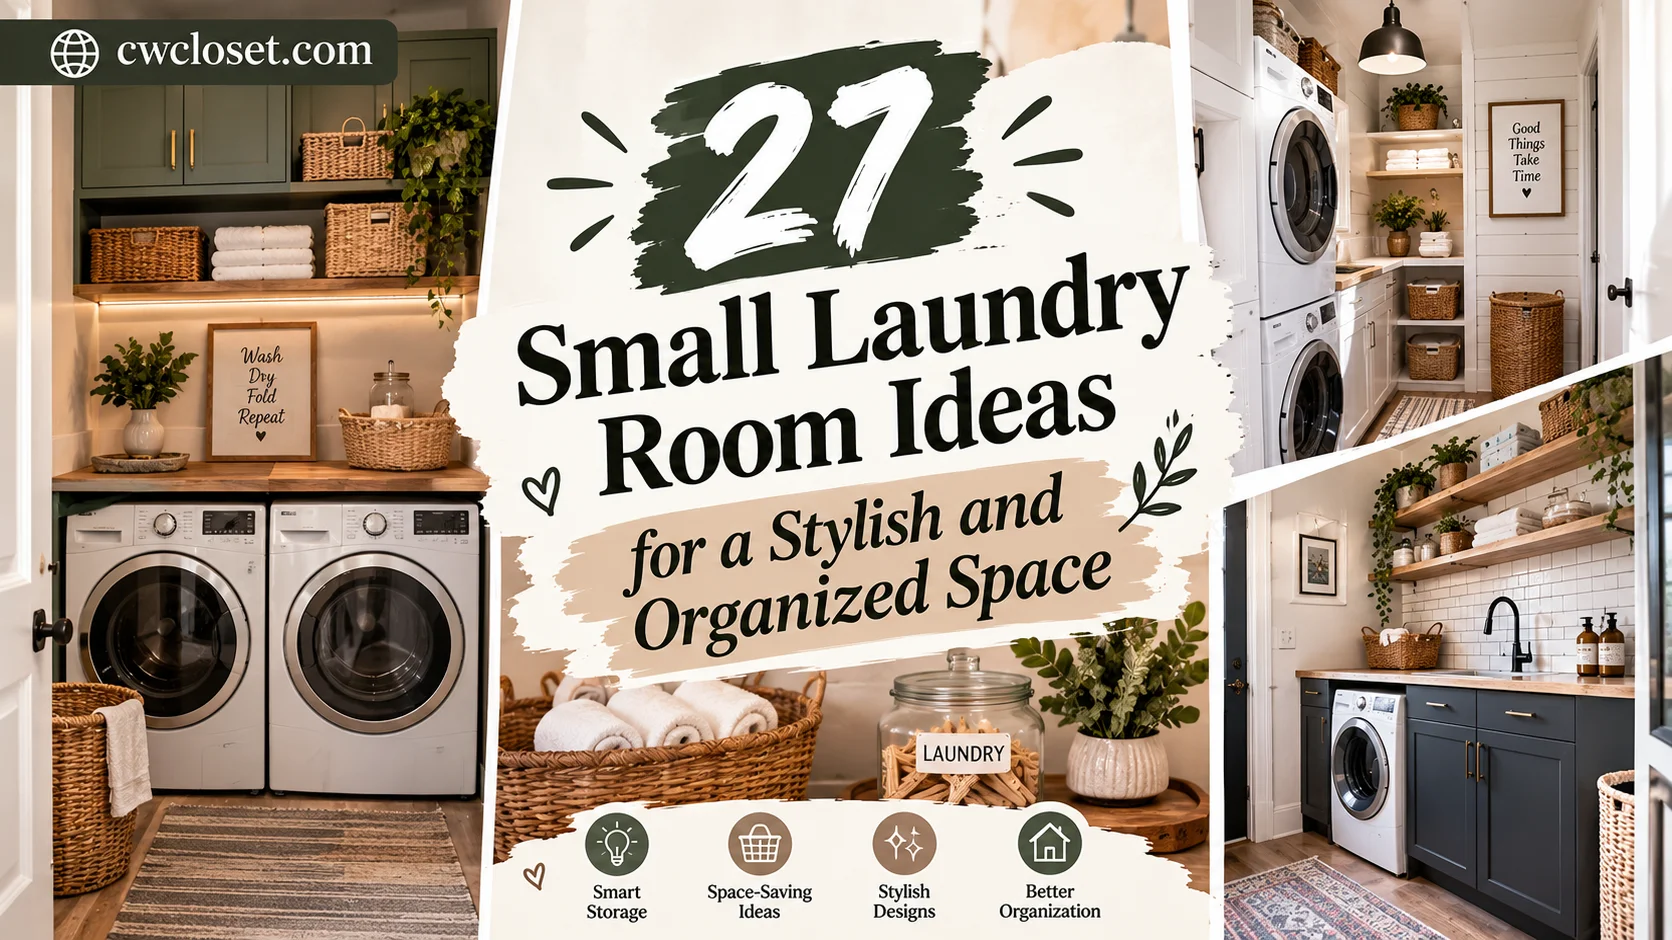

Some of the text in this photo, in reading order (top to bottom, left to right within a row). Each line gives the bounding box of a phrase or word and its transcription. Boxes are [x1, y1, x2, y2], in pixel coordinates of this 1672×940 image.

[1513, 121, 1540, 134] Good
[1508, 138, 1545, 152] Things
[1513, 153, 1541, 167] Take
[1512, 169, 1542, 182] Time
[241, 346, 283, 364] Wash
[249, 368, 277, 388] Dry
[246, 387, 277, 404] Fold
[238, 408, 285, 428] Repeat
[924, 745, 1004, 761] LAUNDRY
